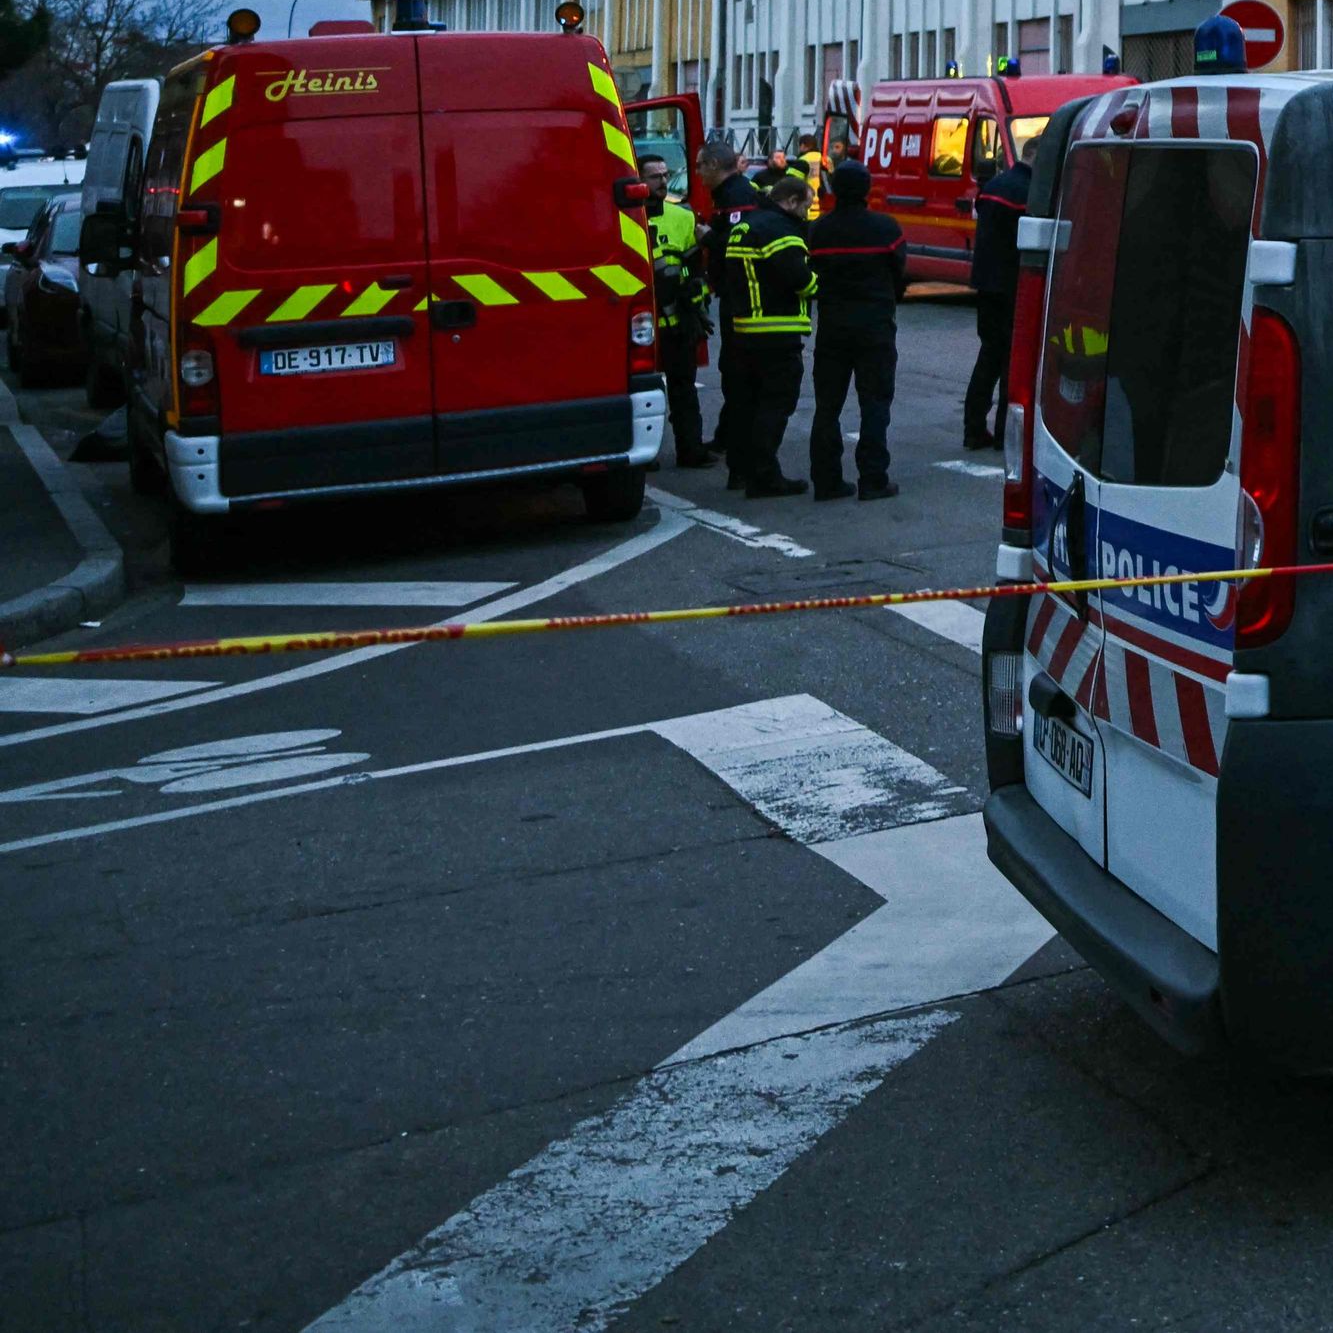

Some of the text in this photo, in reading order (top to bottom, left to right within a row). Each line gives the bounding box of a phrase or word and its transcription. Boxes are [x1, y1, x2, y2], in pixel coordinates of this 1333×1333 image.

[264, 69, 378, 102] Heinis
[864, 128, 894, 169] PC
[273, 344, 380, 371] DE-917-TV
[1102, 540, 1201, 625] POLICE
